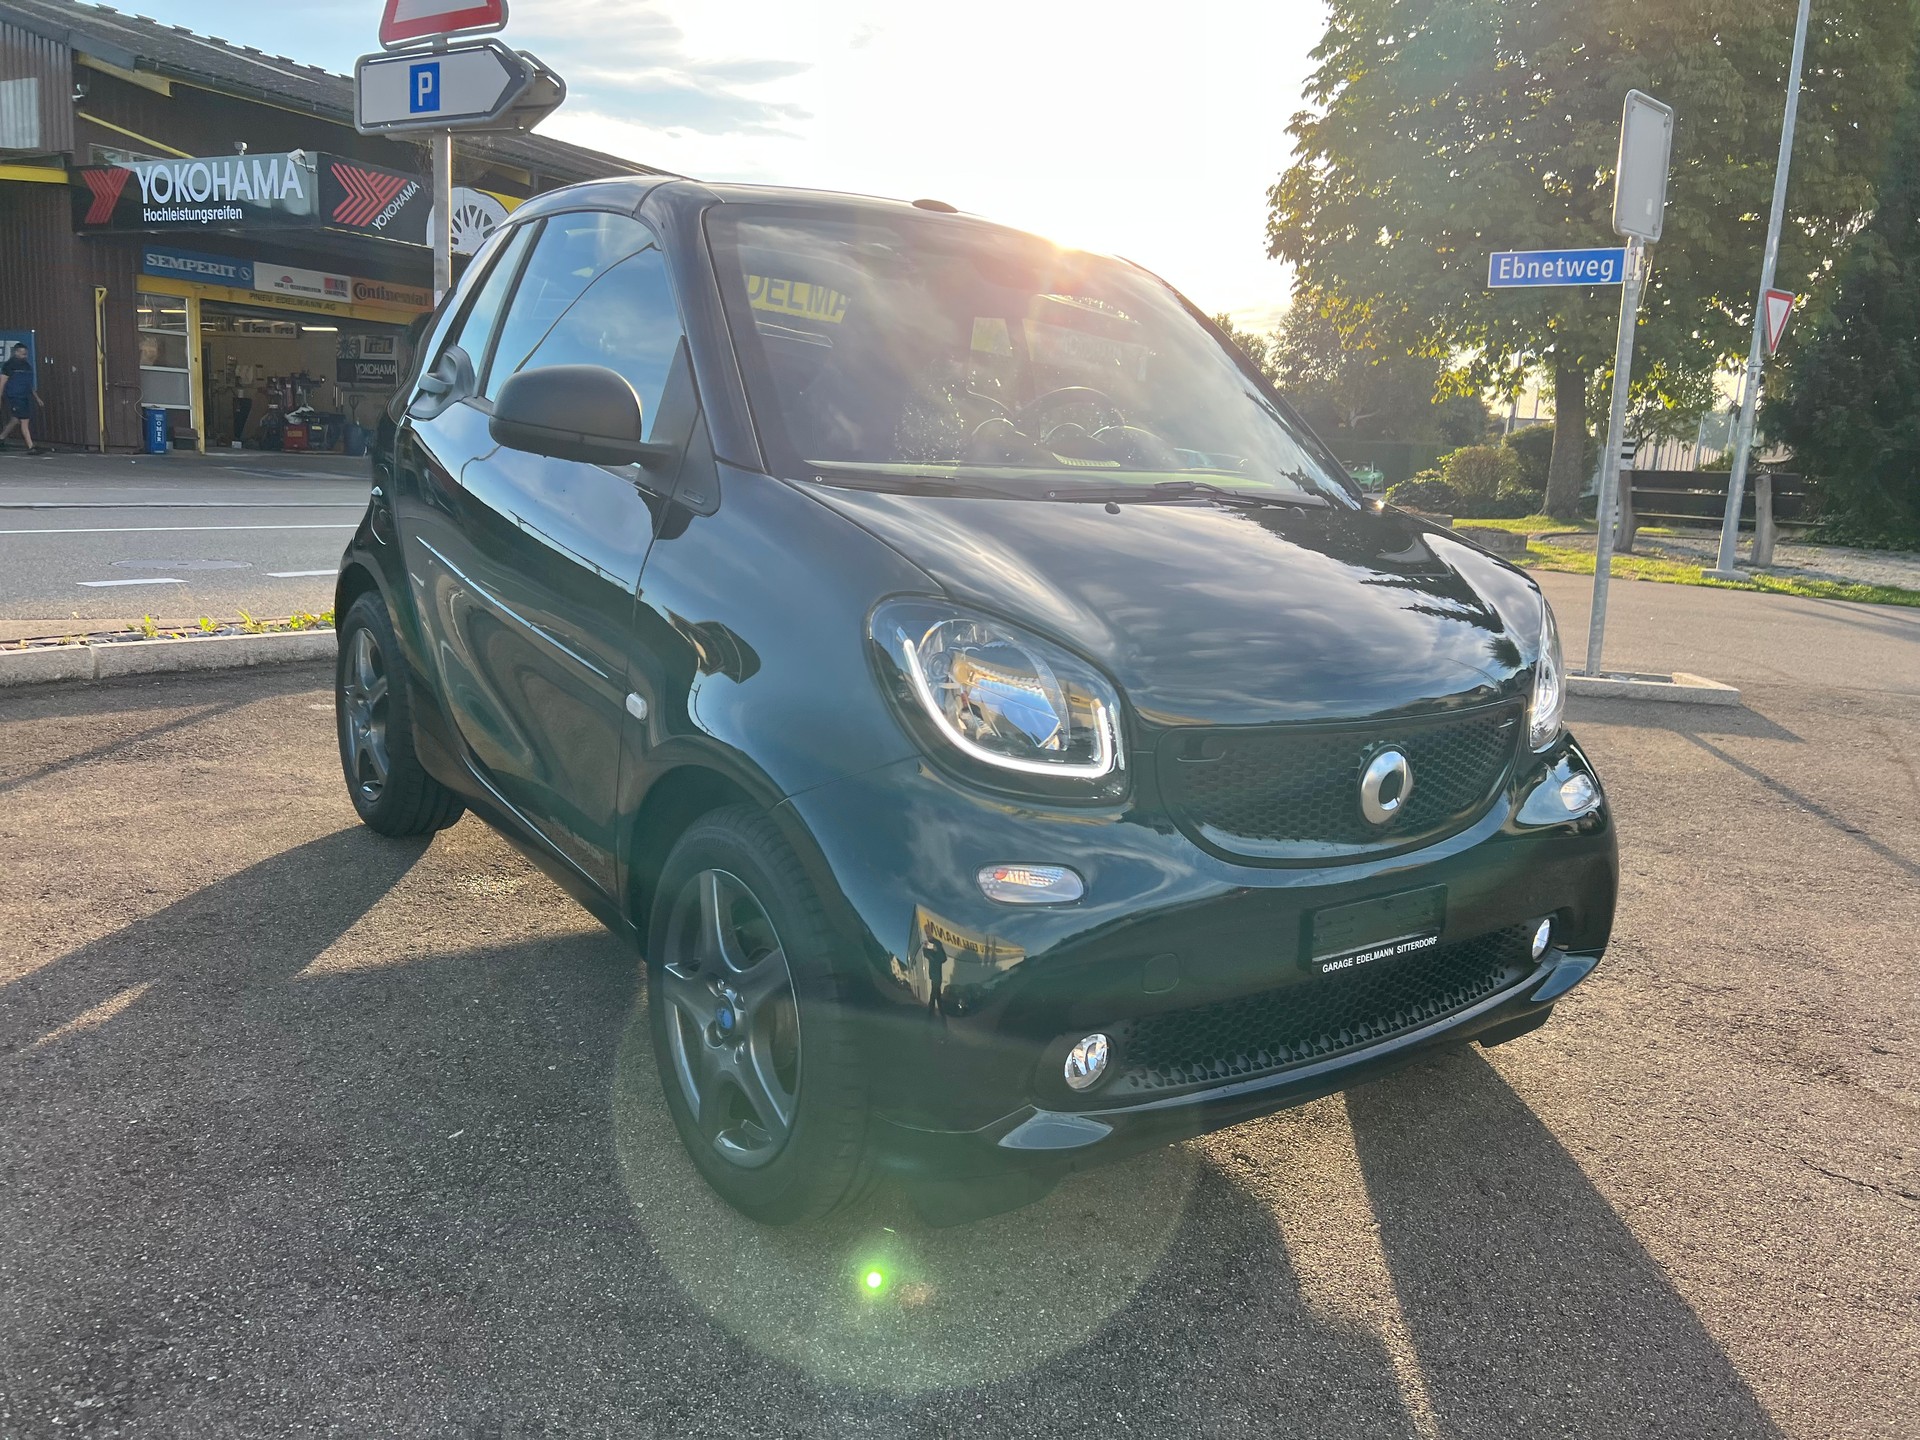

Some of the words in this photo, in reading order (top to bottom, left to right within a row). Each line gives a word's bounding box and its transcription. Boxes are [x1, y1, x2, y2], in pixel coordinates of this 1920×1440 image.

[418, 71, 432, 106] P
[136, 158, 304, 204] YOKOHAMA
[143, 205, 243, 224] Hochleistungsreifen
[372, 181, 420, 230] YOKOHAMA
[146, 253, 237, 278] SEMPERIT
[1500, 257, 1615, 282] Ebnetweg
[353, 282, 429, 307] Continental
[355, 363, 396, 375] YOKOHAMA
[1322, 957, 1353, 973] GARAGE
[1356, 947, 1394, 965] EDELMANN
[1396, 936, 1438, 955] SITTERDORF
